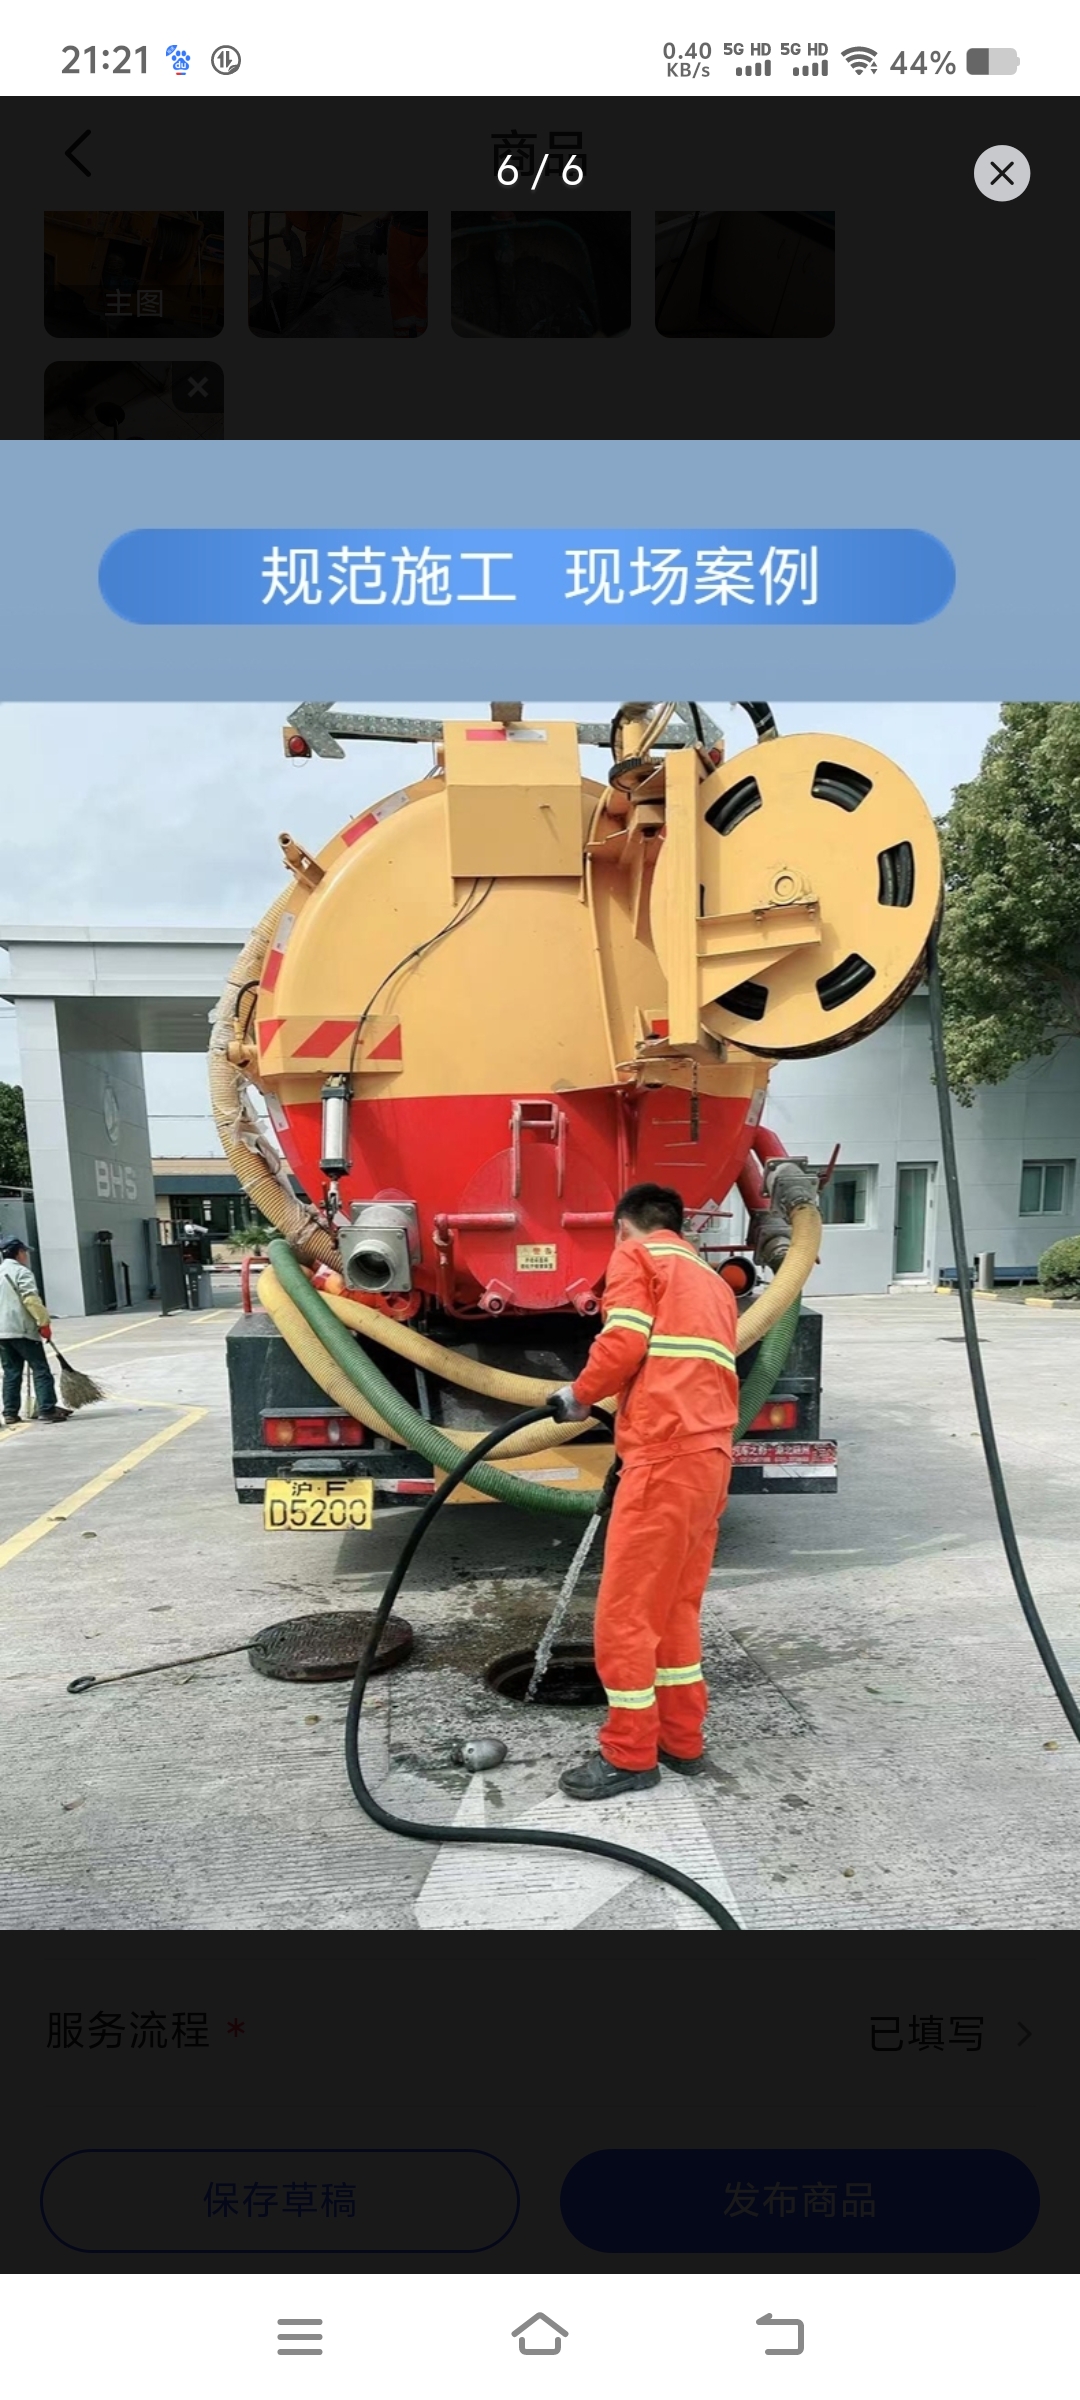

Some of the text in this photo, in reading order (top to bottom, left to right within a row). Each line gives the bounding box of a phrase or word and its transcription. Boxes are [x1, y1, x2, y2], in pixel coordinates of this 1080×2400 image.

[62, 45, 147, 74] 21:21
[663, 42, 712, 60] 0.40
[724, 42, 772, 56] 5G HD
[780, 42, 829, 56] 5G HD
[890, 50, 957, 75] 44%
[667, 62, 711, 79] KB/s
[491, 129, 587, 177] 商品
[105, 288, 163, 318] 主图
[95, 1159, 138, 1201] BHS
[269, 1498, 367, 1527] D5200
[46, 2010, 210, 2050] 服务流程
[870, 2014, 984, 2052] 已填写
[203, 2181, 357, 2218] 保存草稿
[723, 2181, 877, 2218] 发布商品
